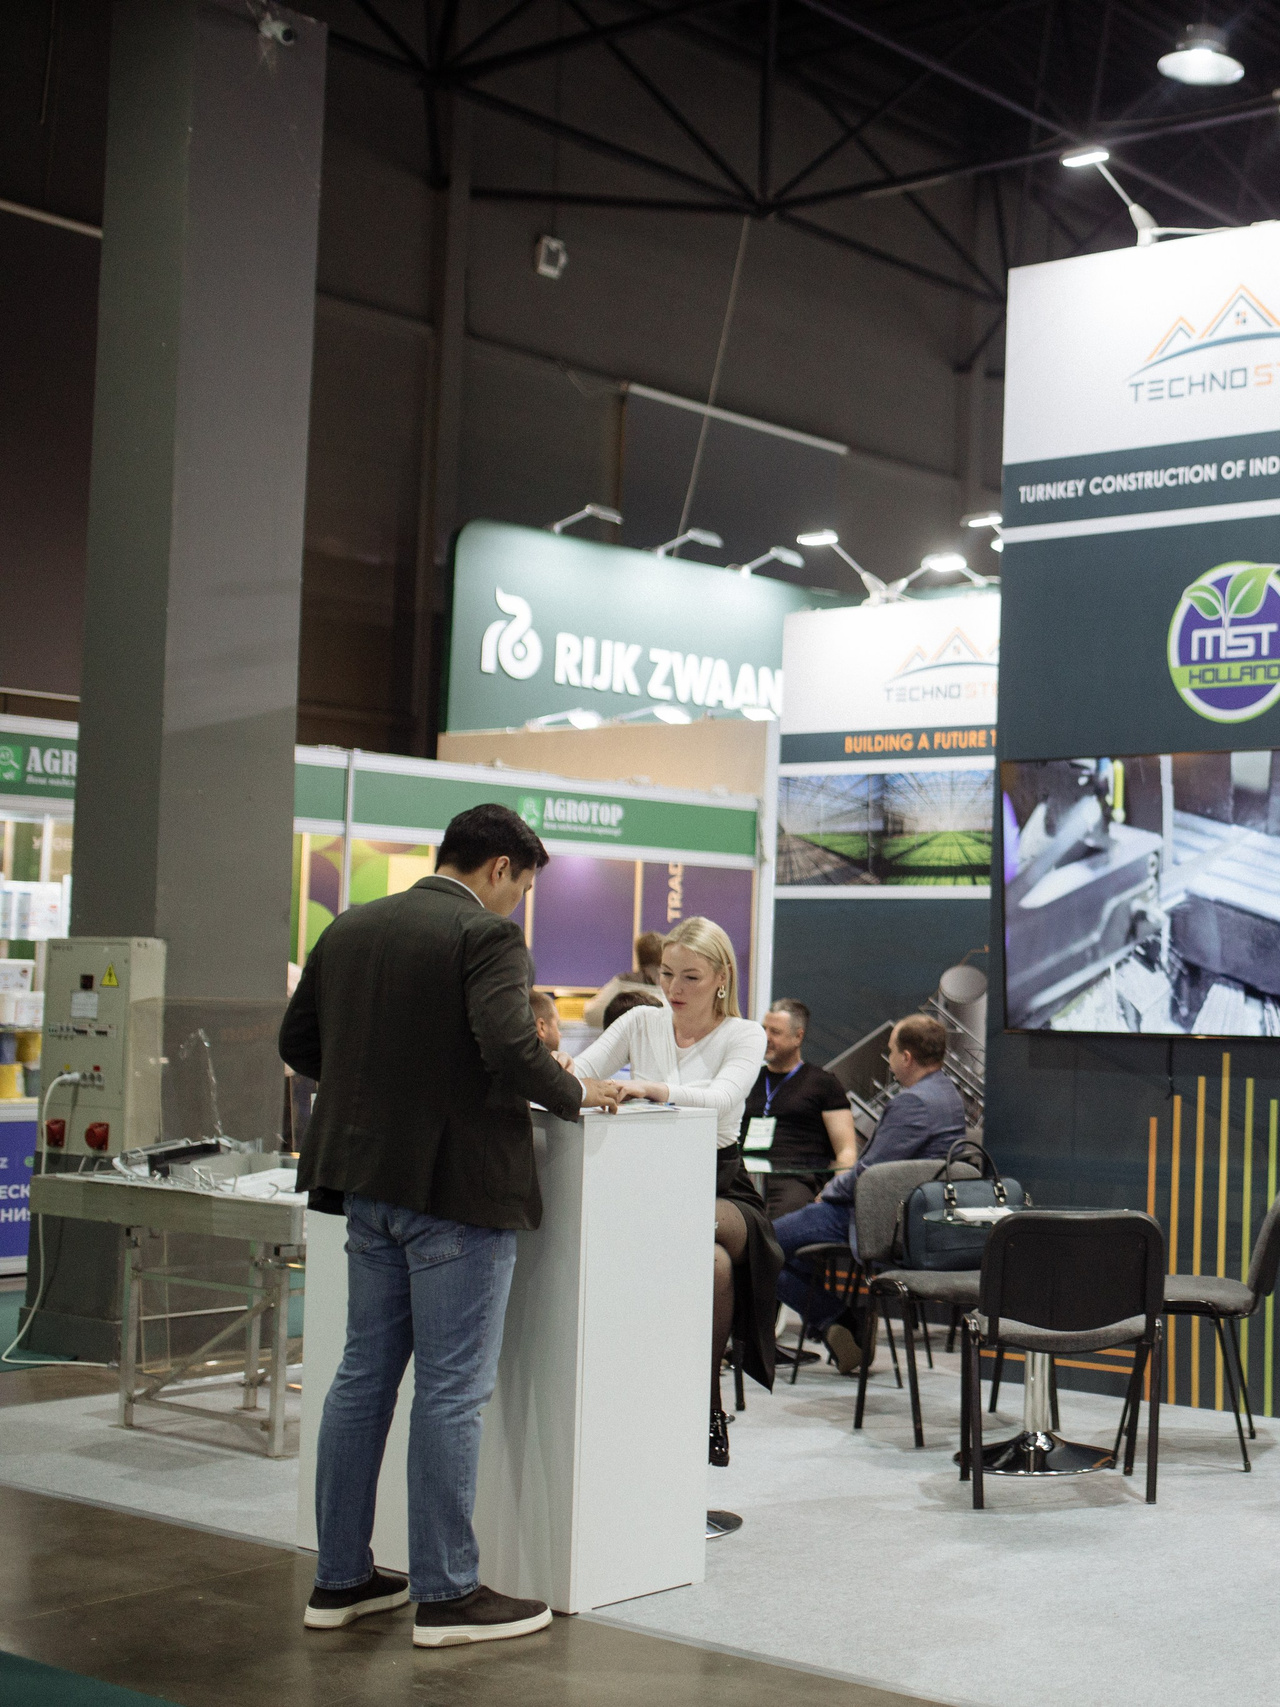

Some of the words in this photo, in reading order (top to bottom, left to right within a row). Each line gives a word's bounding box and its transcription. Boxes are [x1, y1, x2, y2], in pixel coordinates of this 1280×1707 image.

[1019, 478, 1086, 504] TURNKEY
[1088, 464, 1217, 495] CONSTRUCTION
[1220, 459, 1246, 479] OF
[1191, 623, 1279, 661] MST
[554, 632, 642, 696] RIJK
[647, 648, 783, 717] ZWAAN
[1188, 663, 1280, 685] HOLLAND
[844, 733, 914, 754] BUILDING
[918, 732, 930, 751] A
[933, 730, 987, 750] FUTURE
[543, 797, 624, 827] AGROTOP
